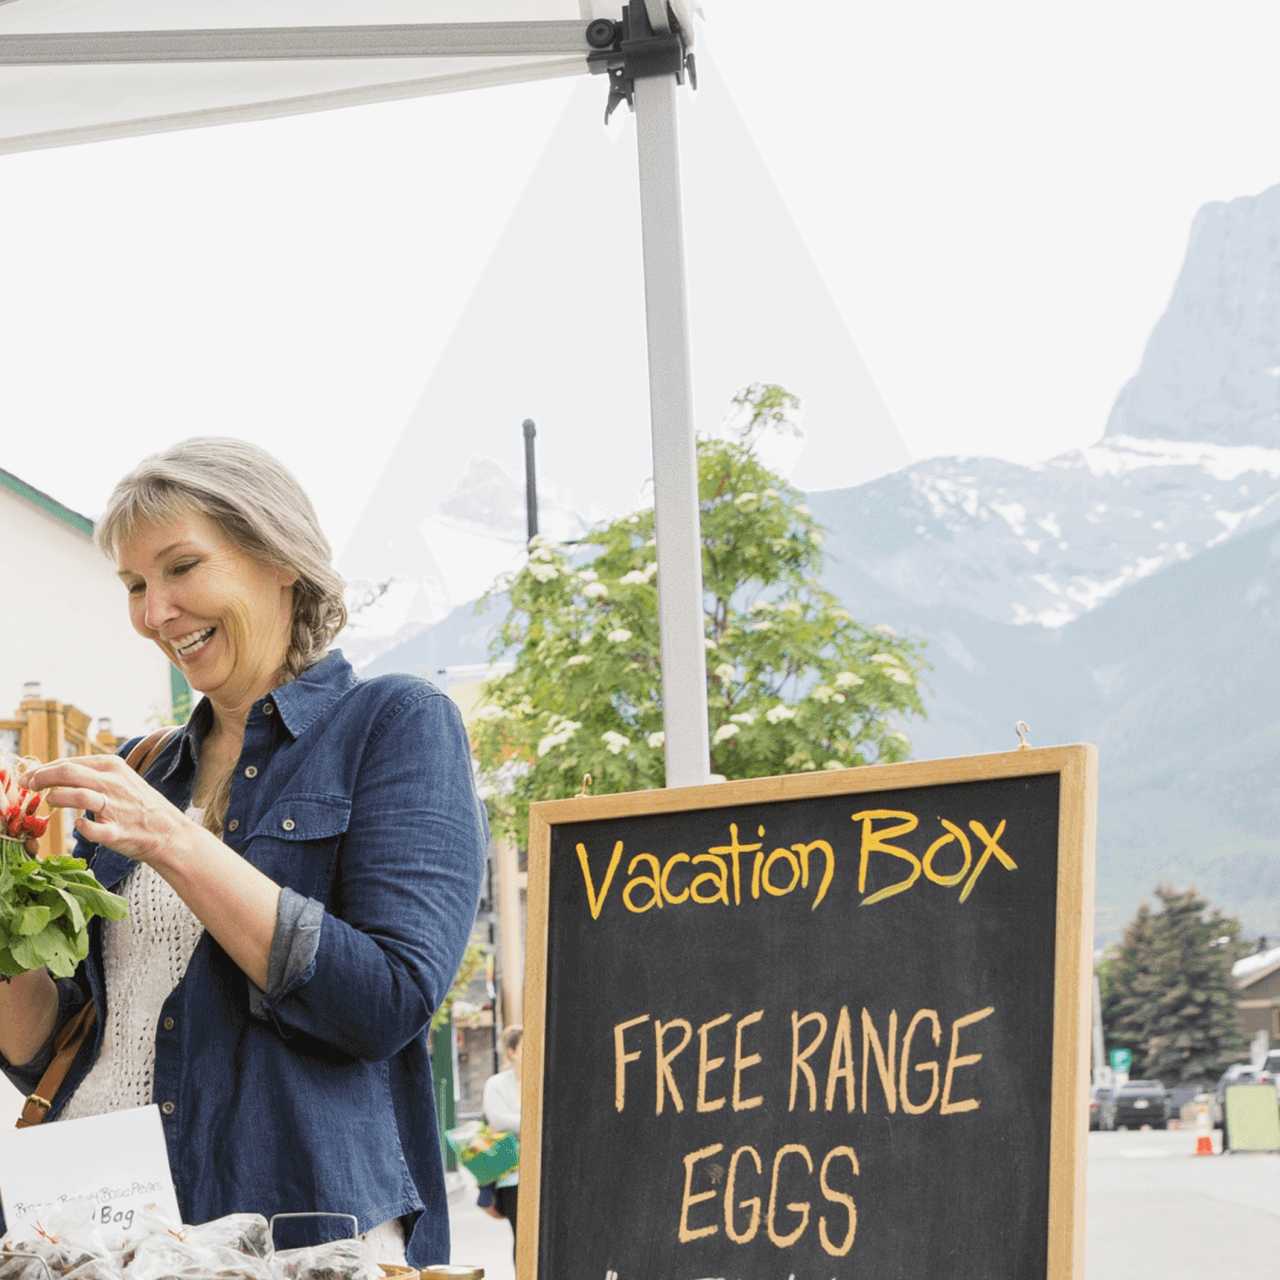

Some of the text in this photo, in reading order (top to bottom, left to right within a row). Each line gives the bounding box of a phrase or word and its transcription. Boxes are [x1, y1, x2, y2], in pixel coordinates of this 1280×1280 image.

[575, 809, 1019, 920] Vacation Box
[614, 1005, 996, 1116] FREE RANGE
[678, 1142, 861, 1257] EGGS
